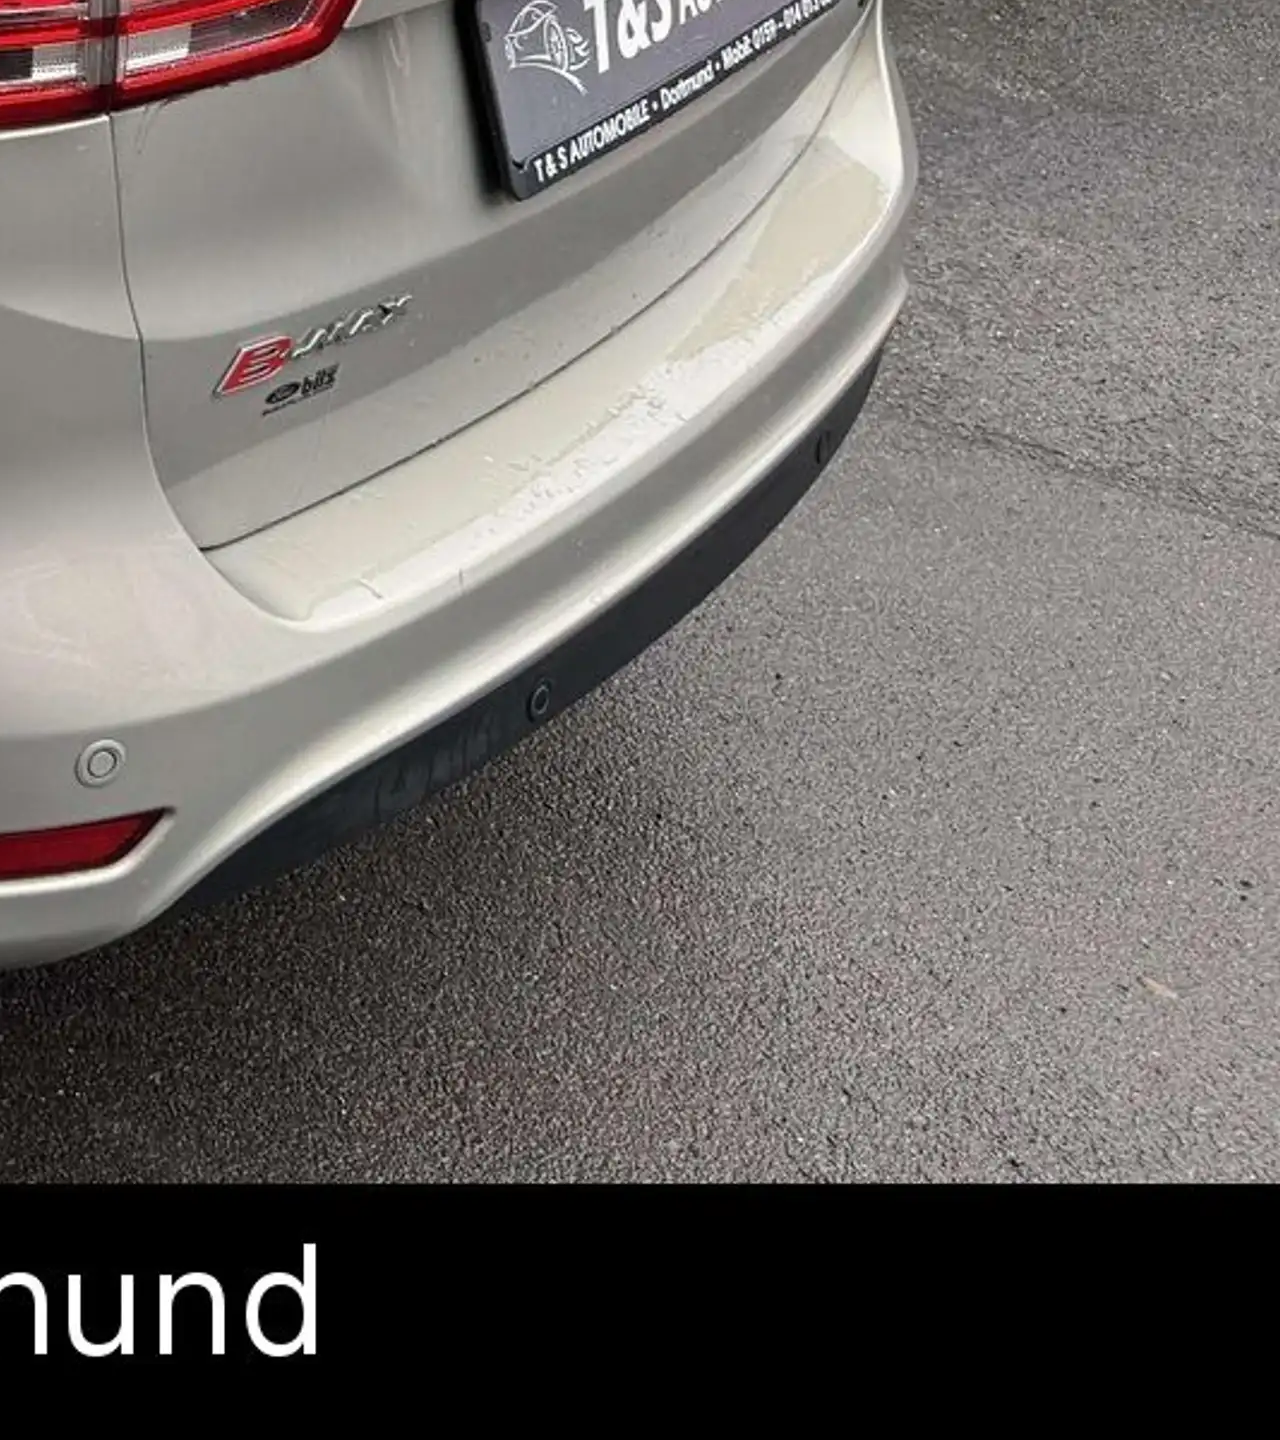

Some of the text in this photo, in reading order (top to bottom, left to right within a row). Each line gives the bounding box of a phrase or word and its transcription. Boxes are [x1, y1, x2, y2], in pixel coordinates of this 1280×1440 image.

[534, 159, 544, 183] T
[545, 153, 559, 177] &
[556, 146, 568, 169] S
[569, 98, 650, 165] AUTOMOBILE
[660, 60, 715, 110] Dortmund
